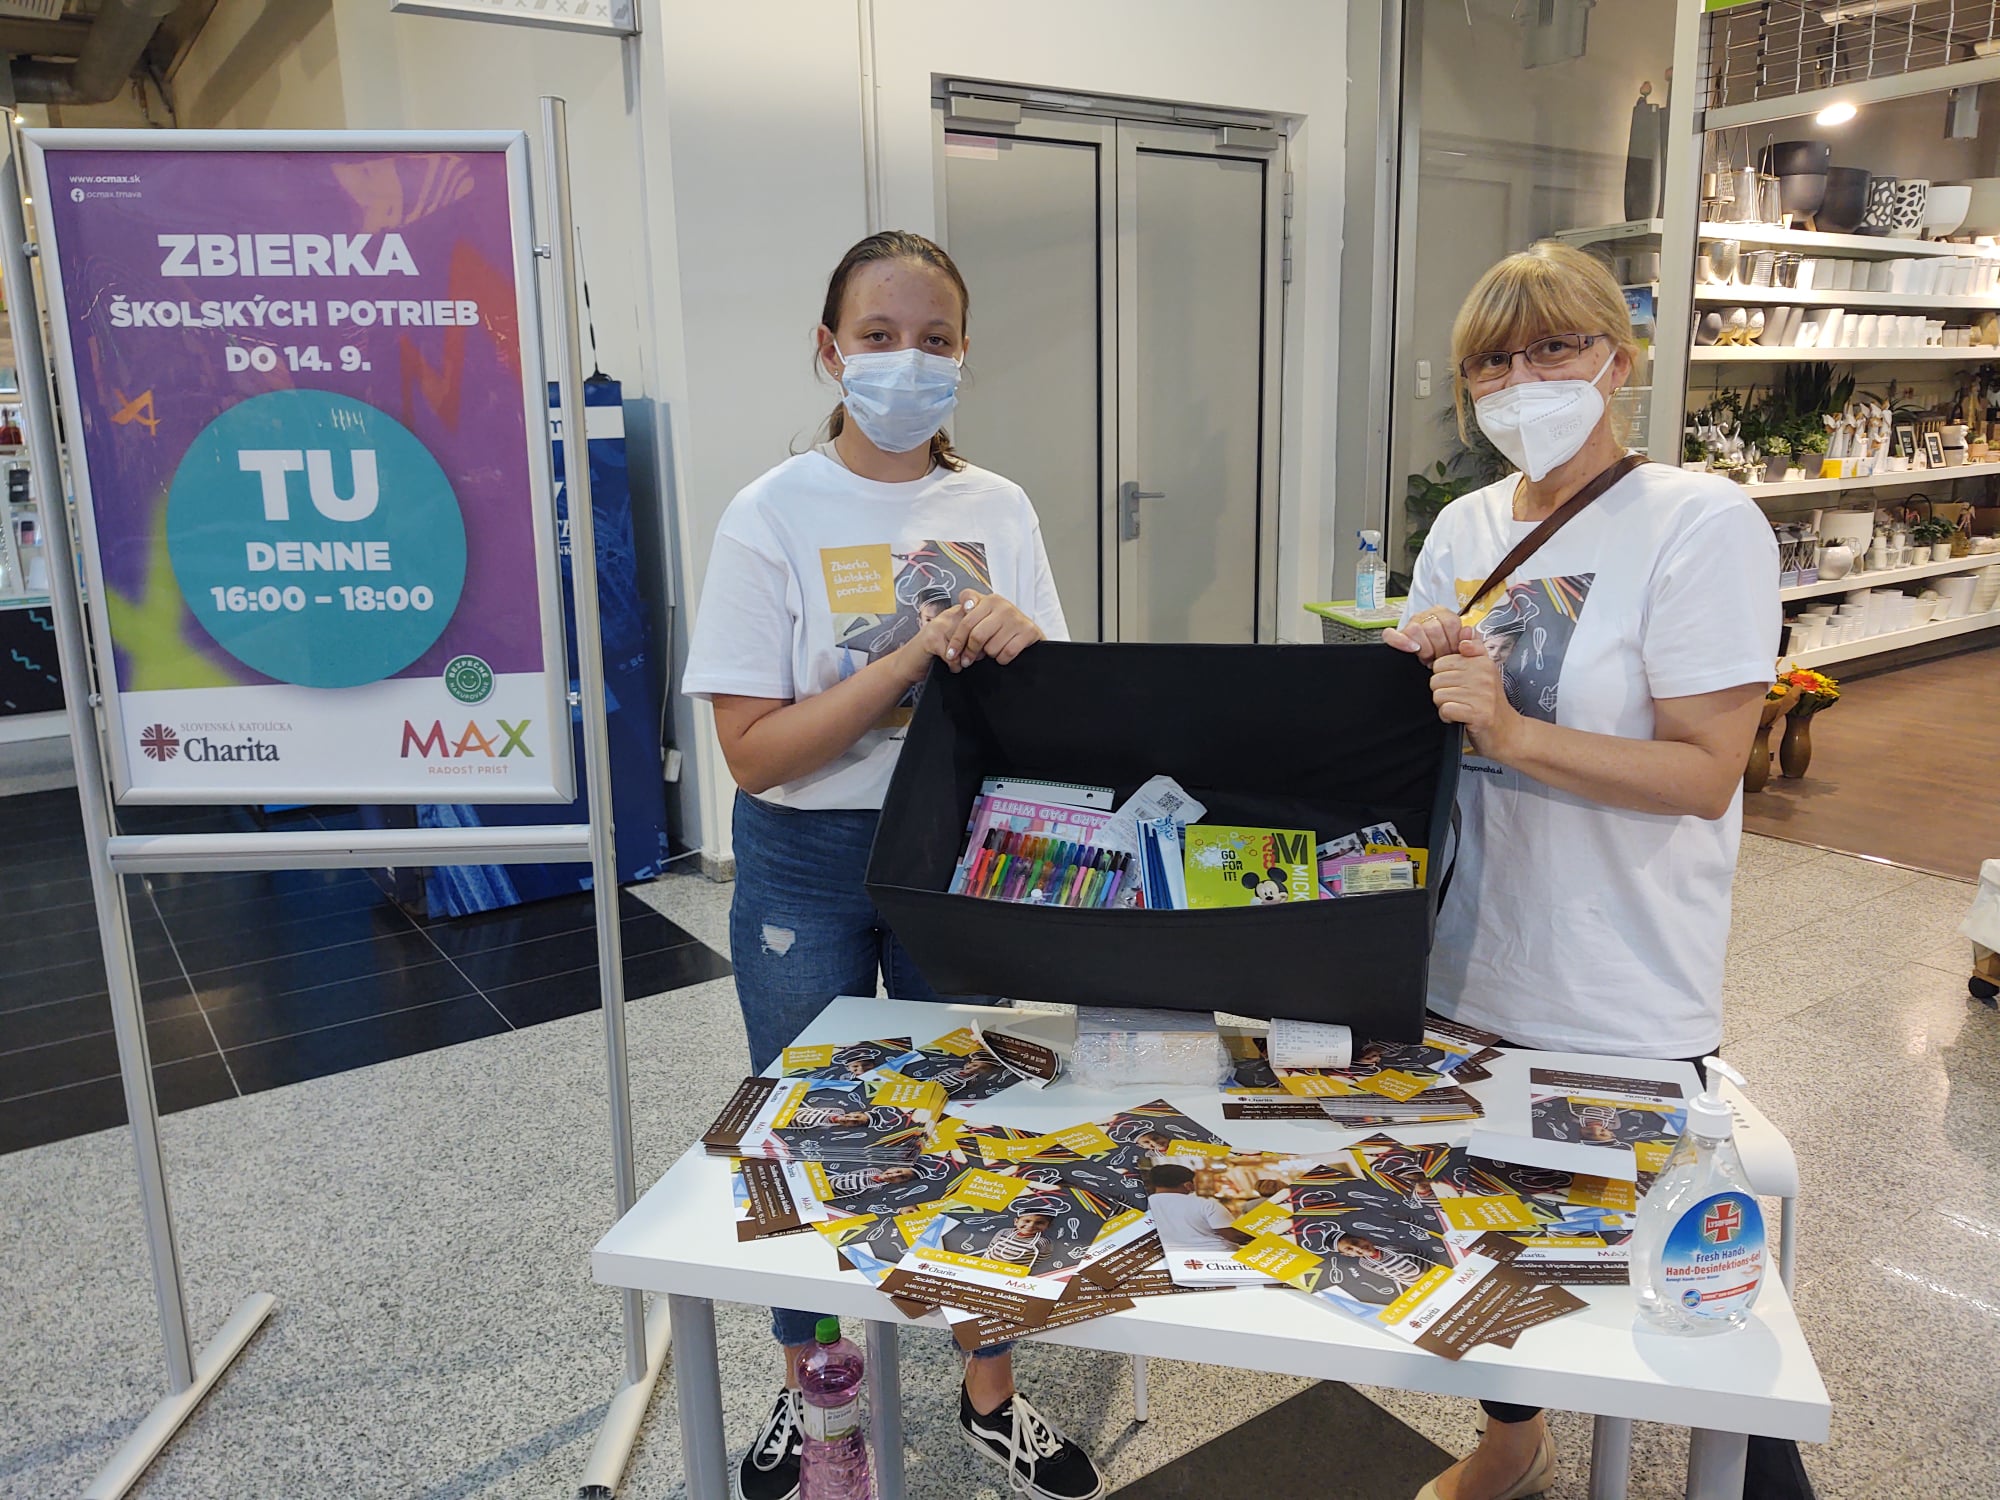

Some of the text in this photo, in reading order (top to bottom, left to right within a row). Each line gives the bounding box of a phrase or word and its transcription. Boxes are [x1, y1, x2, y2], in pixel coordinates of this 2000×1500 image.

[69, 174, 141, 183] www.ocmax.sk
[86, 190, 142, 199] ocmax.trnava
[157, 233, 420, 278] ZBIERKA
[109, 294, 480, 329] ŠKOLSKÝCH POTRIEB
[226, 346, 371, 373] DO 14. 9.
[237, 449, 381, 522] TU
[246, 541, 392, 572] DENNE
[832, 559, 870, 572] Zbierka
[834, 570, 881, 585] školských
[210, 586, 306, 612] 16:00
[339, 585, 434, 611] 18:00
[180, 720, 293, 733] SLOVENSKÁ KATOLÍCKA
[400, 719, 535, 759] MAX
[184, 737, 280, 763] Charita
[428, 764, 475, 775] RADOSŤ
[992, 800, 1036, 818] WHITE
[1039, 810, 1069, 823] PAD
[1221, 849, 1236, 860] GO
[1222, 860, 1244, 871] FOR
[1223, 871, 1238, 882] IT!
[1696, 1245, 1746, 1263] Fresh Hands
[1666, 1249, 1761, 1276] Hand-Desinfektions-Gel
[1005, 1278, 1038, 1291] MAX
